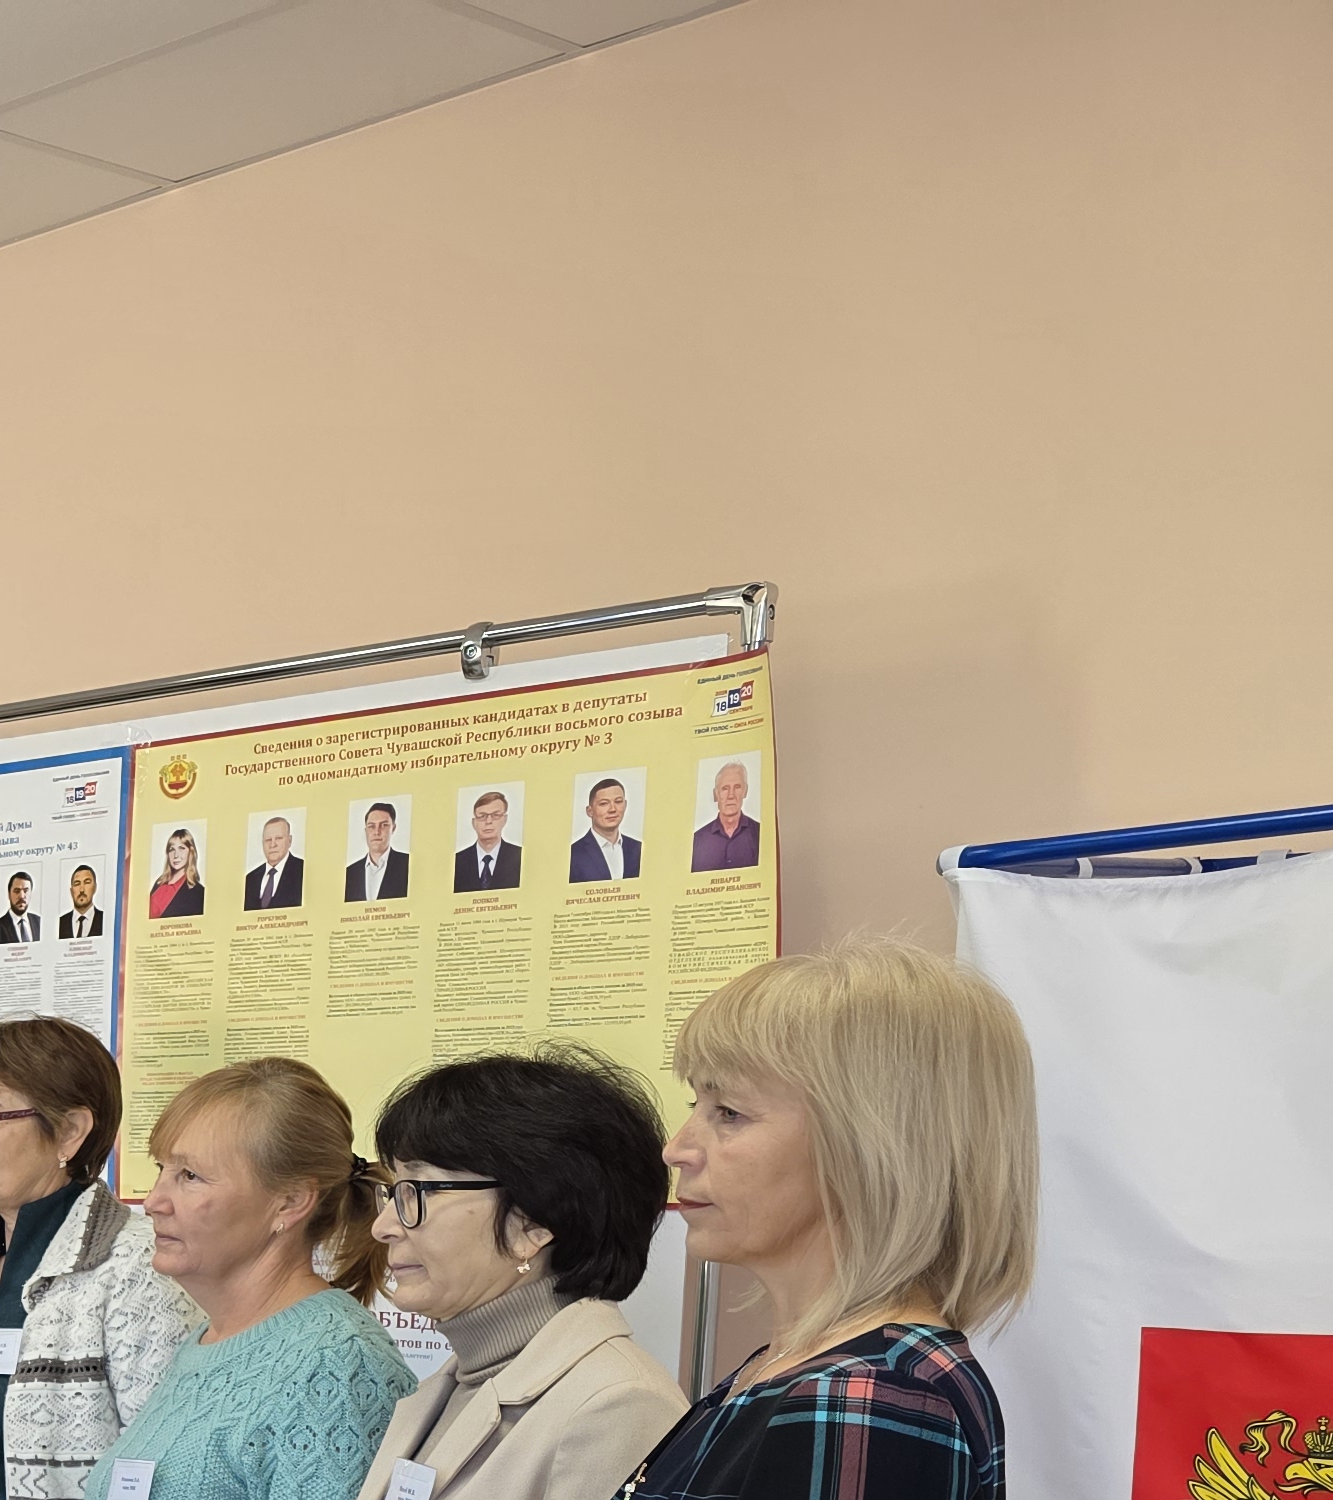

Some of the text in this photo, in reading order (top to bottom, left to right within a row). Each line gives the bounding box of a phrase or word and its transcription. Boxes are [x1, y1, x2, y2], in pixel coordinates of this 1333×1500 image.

[716, 685, 752, 712] 18 19 20
[253, 691, 647, 755] Сведения о зарегистрированных кандидатах в депутаты
[225, 705, 683, 776] Государственного Совета Чувашской Республики восьмого созыва
[278, 732, 613, 786] по одномандатному избирательному округу № 3
[76, 790, 83, 799] 19
[85, 784, 95, 794] 20
[5, 820, 33, 834] Думы
[25, 846, 55, 856] округу
[67, 842, 79, 850] 43
[686, 885, 725, 896] ВЛАДИМИР
[602, 894, 640, 903] СЕРГЕЕВИЧ
[371, 1310, 436, 1334] БЪЕД
[425, 1342, 441, 1350] по
